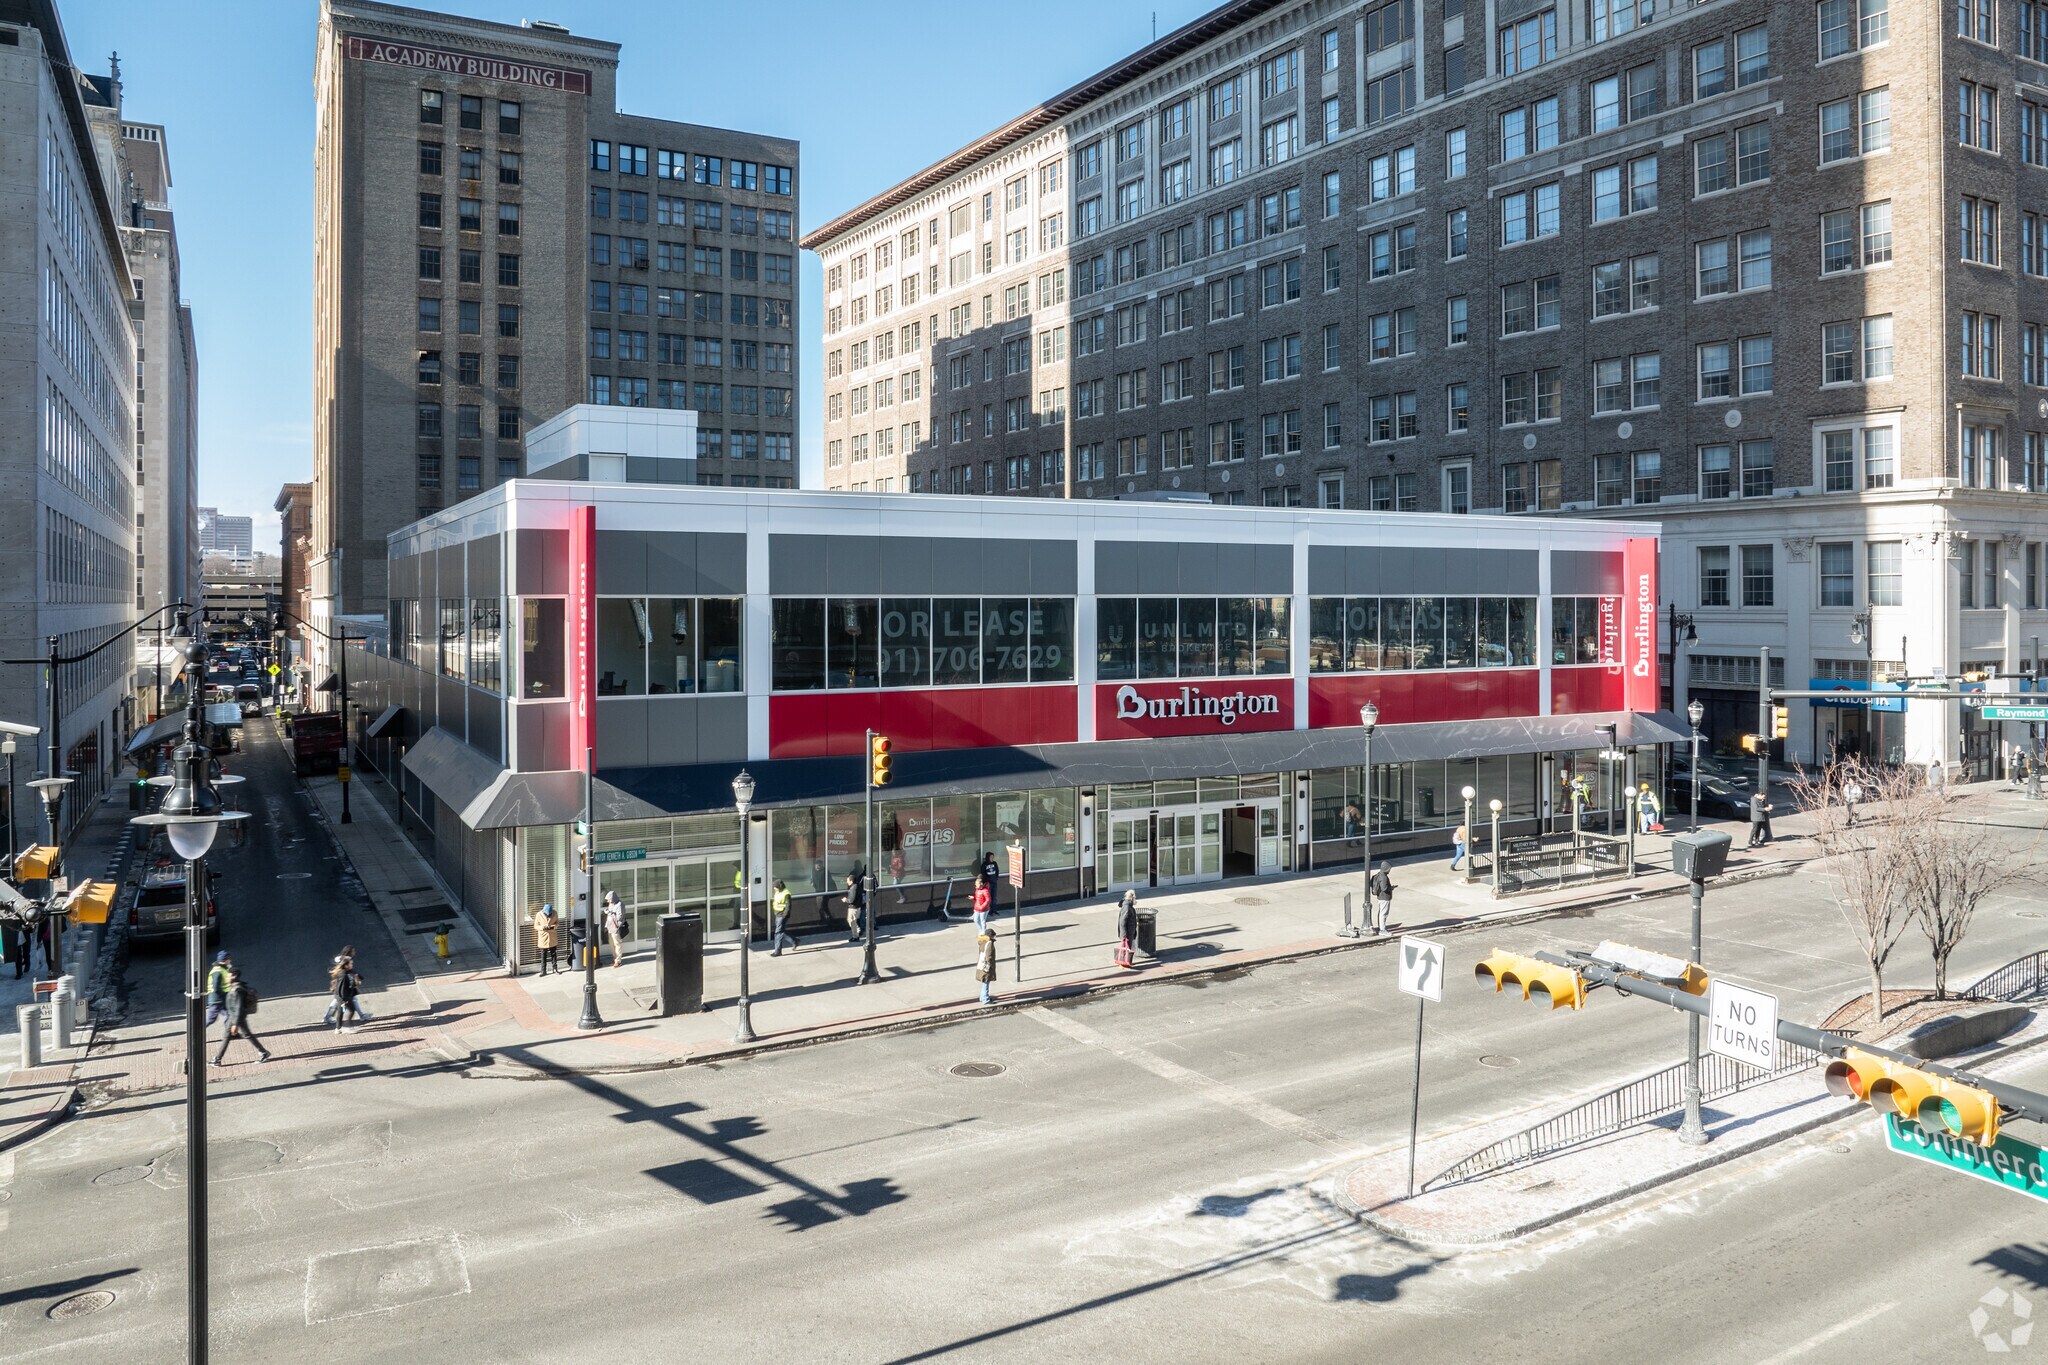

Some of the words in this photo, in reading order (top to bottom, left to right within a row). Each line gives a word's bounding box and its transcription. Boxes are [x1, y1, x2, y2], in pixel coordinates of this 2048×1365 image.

[371, 44, 464, 73] ACADEMY
[467, 59, 556, 87] BUILDING
[945, 610, 1044, 637] LEASE
[1144, 622, 1248, 638] UNLMTD
[1388, 606, 1454, 630] LEASE
[1633, 573, 1654, 677] Burlington
[934, 645, 1062, 671] 706-7629
[1117, 685, 1279, 725] Burlington
[1997, 709, 2045, 718] Raymond
[904, 829, 954, 847] DEALS
[1730, 1000, 1756, 1025] NO
[1715, 1024, 1770, 1056] TURNS
